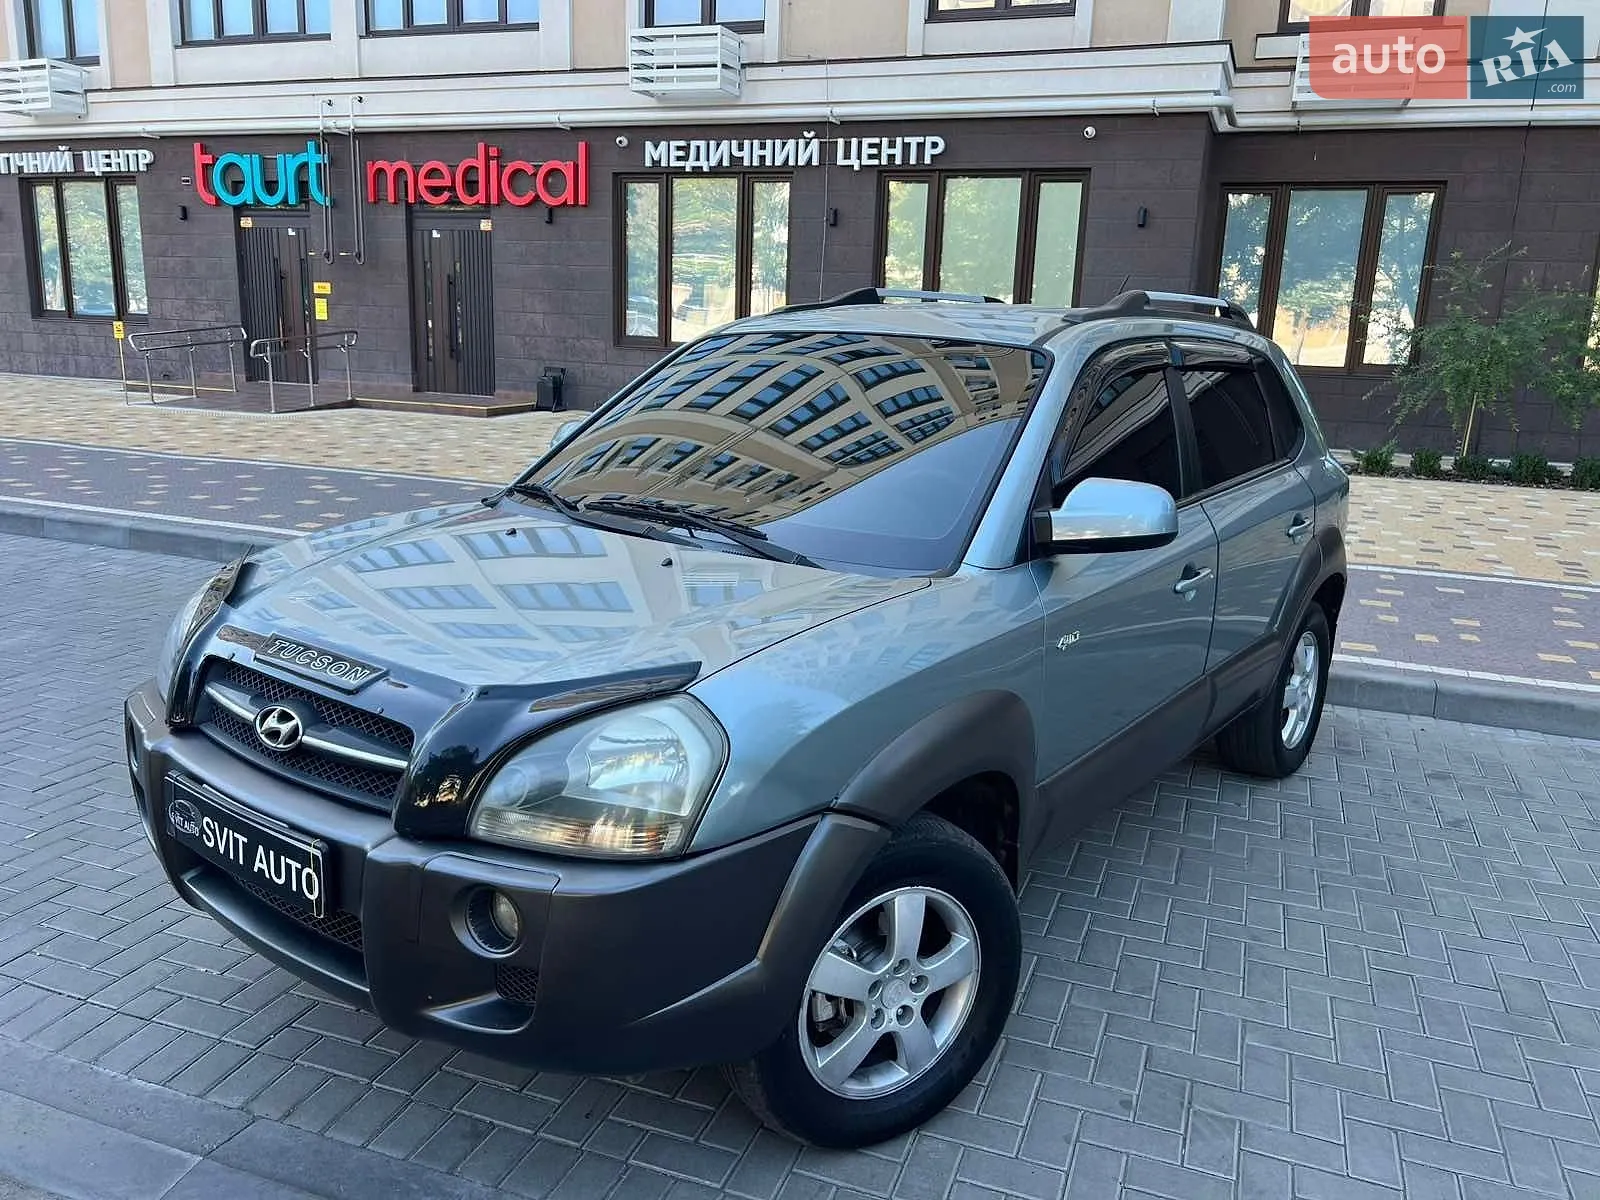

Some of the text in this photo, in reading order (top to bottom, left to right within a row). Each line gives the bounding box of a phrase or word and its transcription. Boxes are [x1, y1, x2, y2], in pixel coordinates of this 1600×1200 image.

[82, 149, 154, 176] ЦЕНТР
[193, 140, 591, 207] taurt medical
[644, 130, 946, 172] МЕДИЧНИЙ ЦЕНТР
[267, 639, 370, 684] TUCSON
[202, 816, 319, 900] SVIT AUTO
